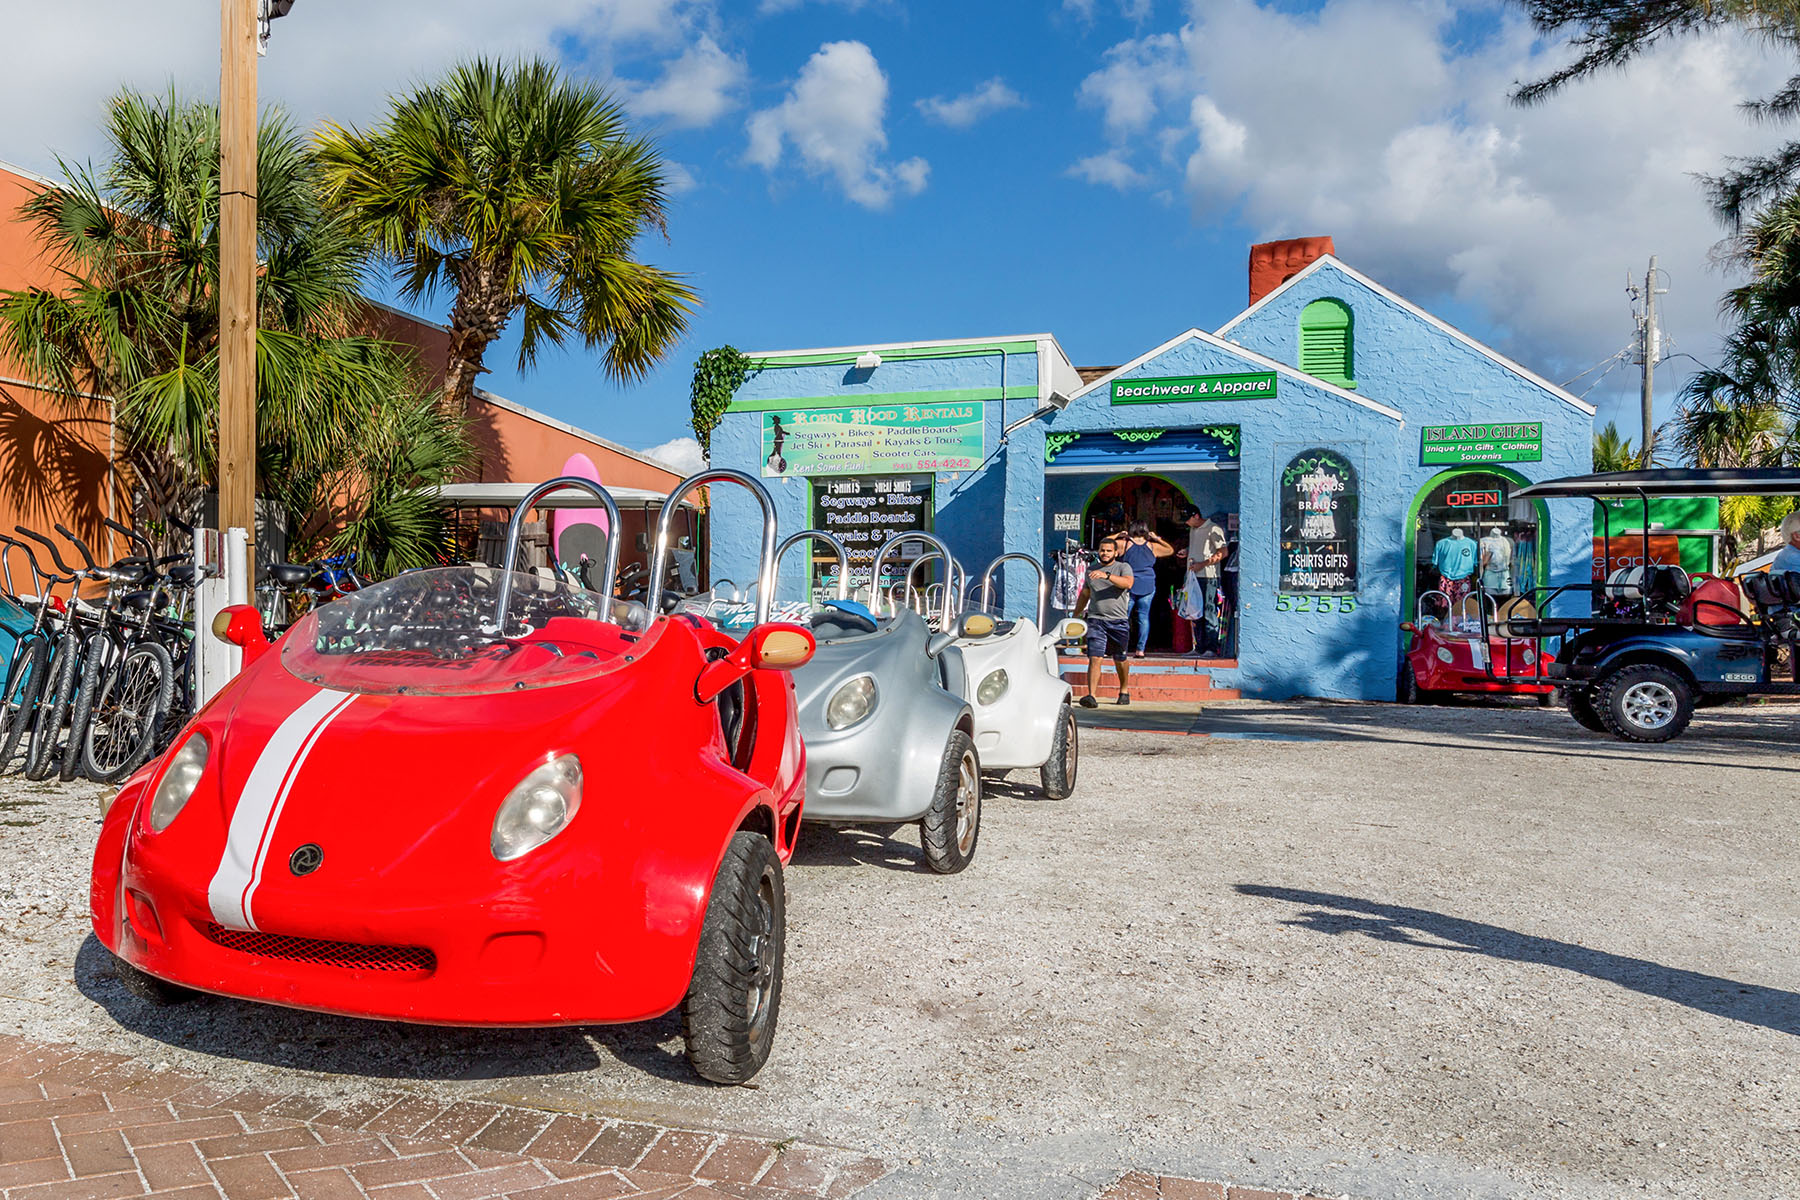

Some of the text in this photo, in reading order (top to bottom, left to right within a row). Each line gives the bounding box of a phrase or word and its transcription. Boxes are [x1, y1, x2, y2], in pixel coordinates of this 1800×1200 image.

[1116, 378, 1272, 397] Beachwear & Apparel
[903, 406, 973, 422] RENTALS
[794, 431, 837, 440] Segways
[848, 429, 875, 437] Bikes
[1425, 424, 1539, 441] ISLAND GIFTS
[790, 436, 962, 450] Jet Ski Parasail Kayaks & Tours
[1425, 442, 1539, 454] Unique Fun Gifts Clothing
[817, 449, 936, 461] Scooters Scooter Cars
[1460, 453, 1503, 461] Souvenirs
[792, 463, 815, 473] Rent
[816, 462, 843, 473] Some
[844, 460, 865, 471] Fun!
[917, 458, 971, 469] 554-4242
[1301, 474, 1339, 483] HEA
[820, 493, 923, 509] Segways Bikes
[1298, 500, 1338, 510] BRAIDS
[1446, 492, 1498, 506] OPEN
[1305, 518, 1330, 527] HAI
[871, 529, 882, 541] &
[1288, 554, 1348, 568] T-SHIRTS GIFTS
[1291, 572, 1345, 586] & SOUVENIRS
[1276, 594, 1357, 613] 5255
[728, 610, 814, 624] RETALS
